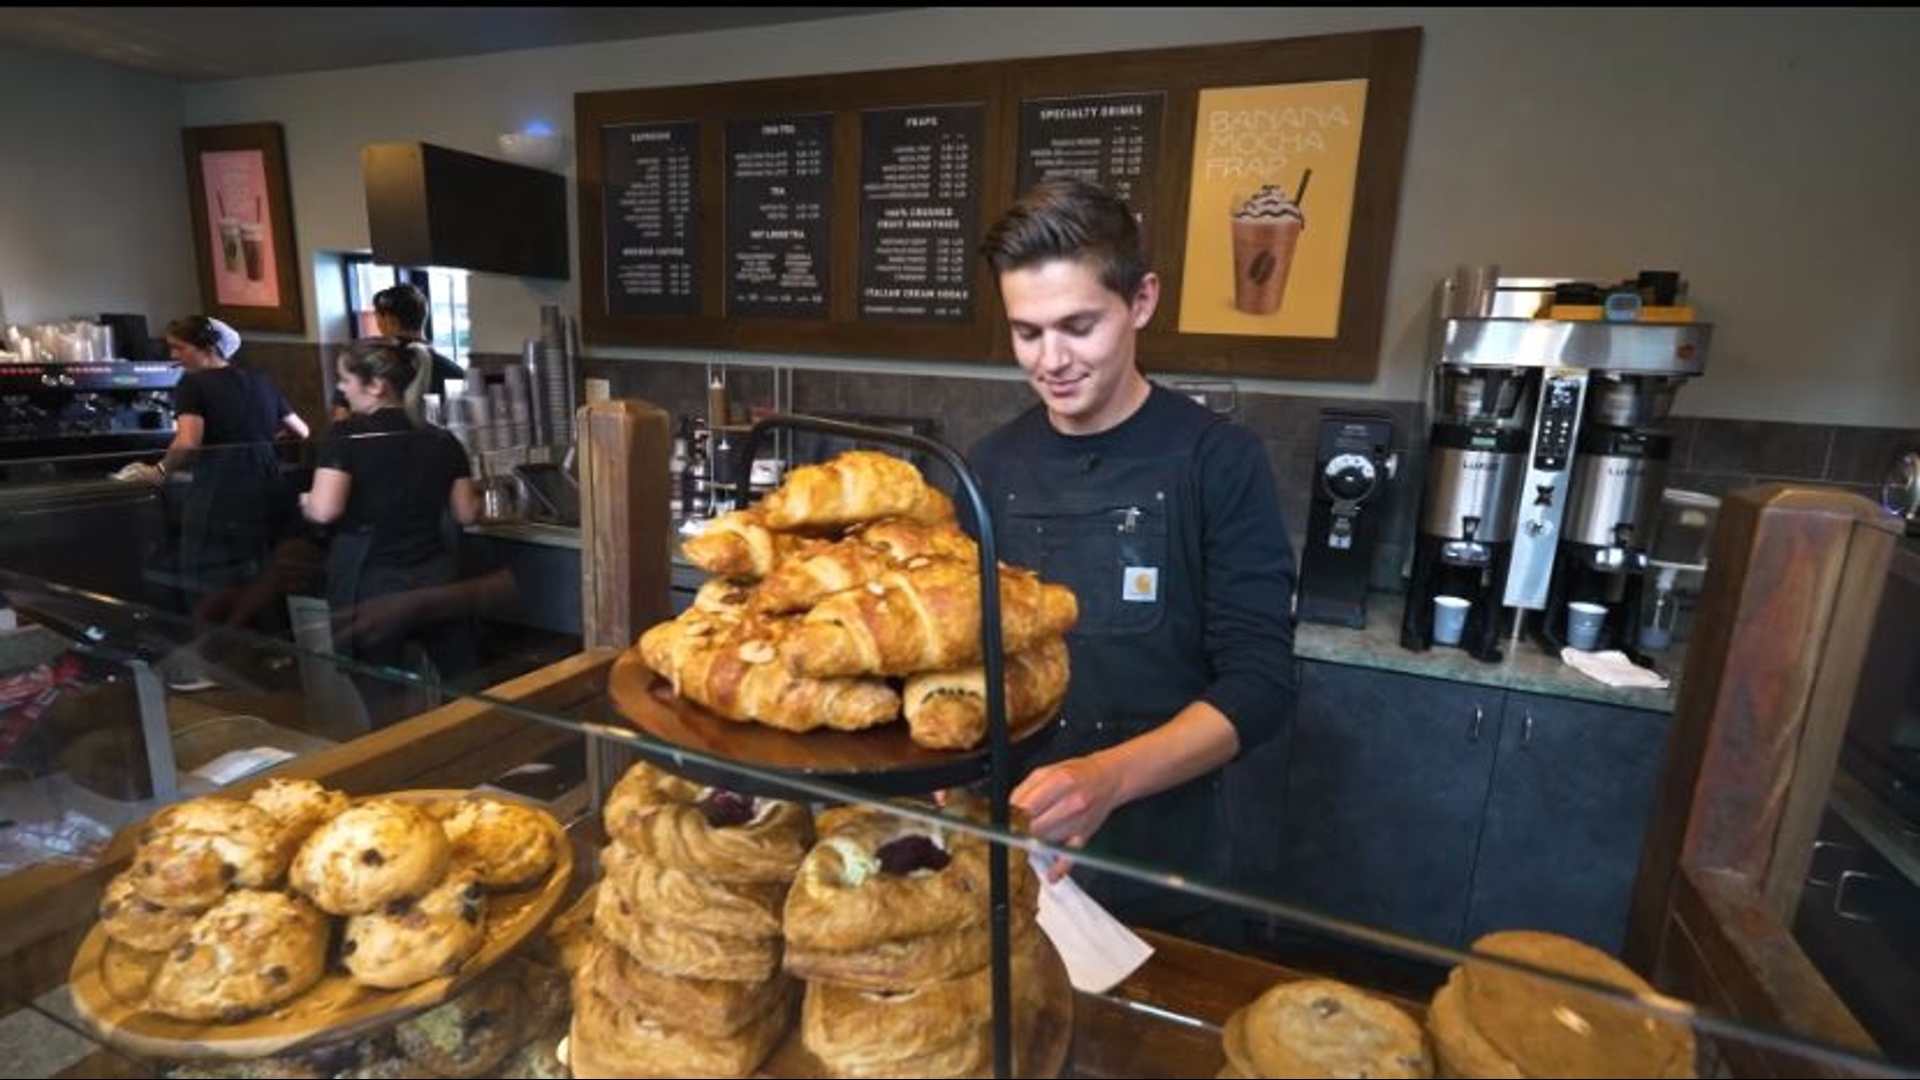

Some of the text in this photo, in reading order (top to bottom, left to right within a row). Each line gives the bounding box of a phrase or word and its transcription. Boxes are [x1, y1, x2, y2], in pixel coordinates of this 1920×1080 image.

[1040, 104, 1143, 120] SPECIALTY DRINKS
[1208, 105, 1350, 133] BANANA
[1206, 130, 1326, 156] MOCHA
[1204, 154, 1288, 183] FRAP
